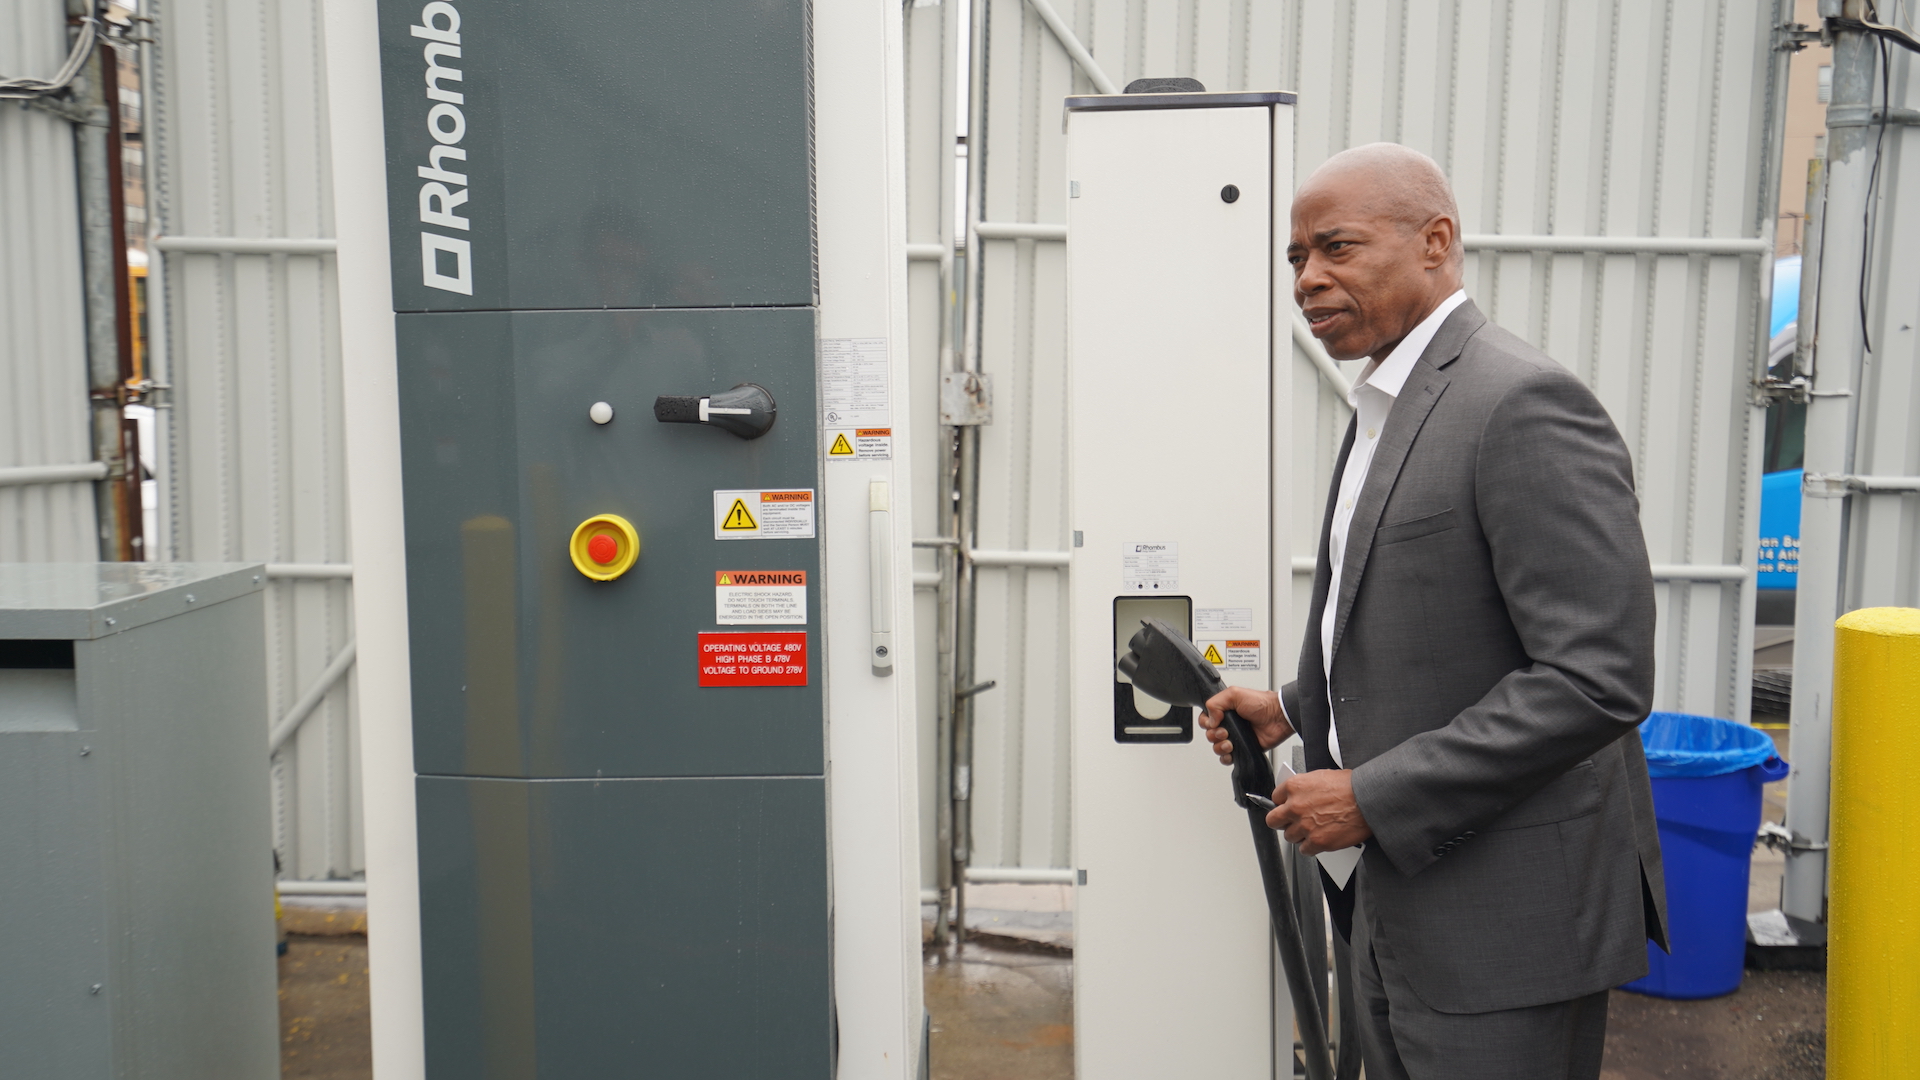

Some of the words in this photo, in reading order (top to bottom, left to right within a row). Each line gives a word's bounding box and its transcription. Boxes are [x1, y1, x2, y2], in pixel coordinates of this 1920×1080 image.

[410, 1, 469, 231] Rhomb
[734, 574, 803, 584] WARNING
[703, 644, 747, 652] OPERATING
[748, 644, 782, 652] VOLTAGE
[784, 644, 802, 652] 480V
[738, 655, 763, 663] PHASE
